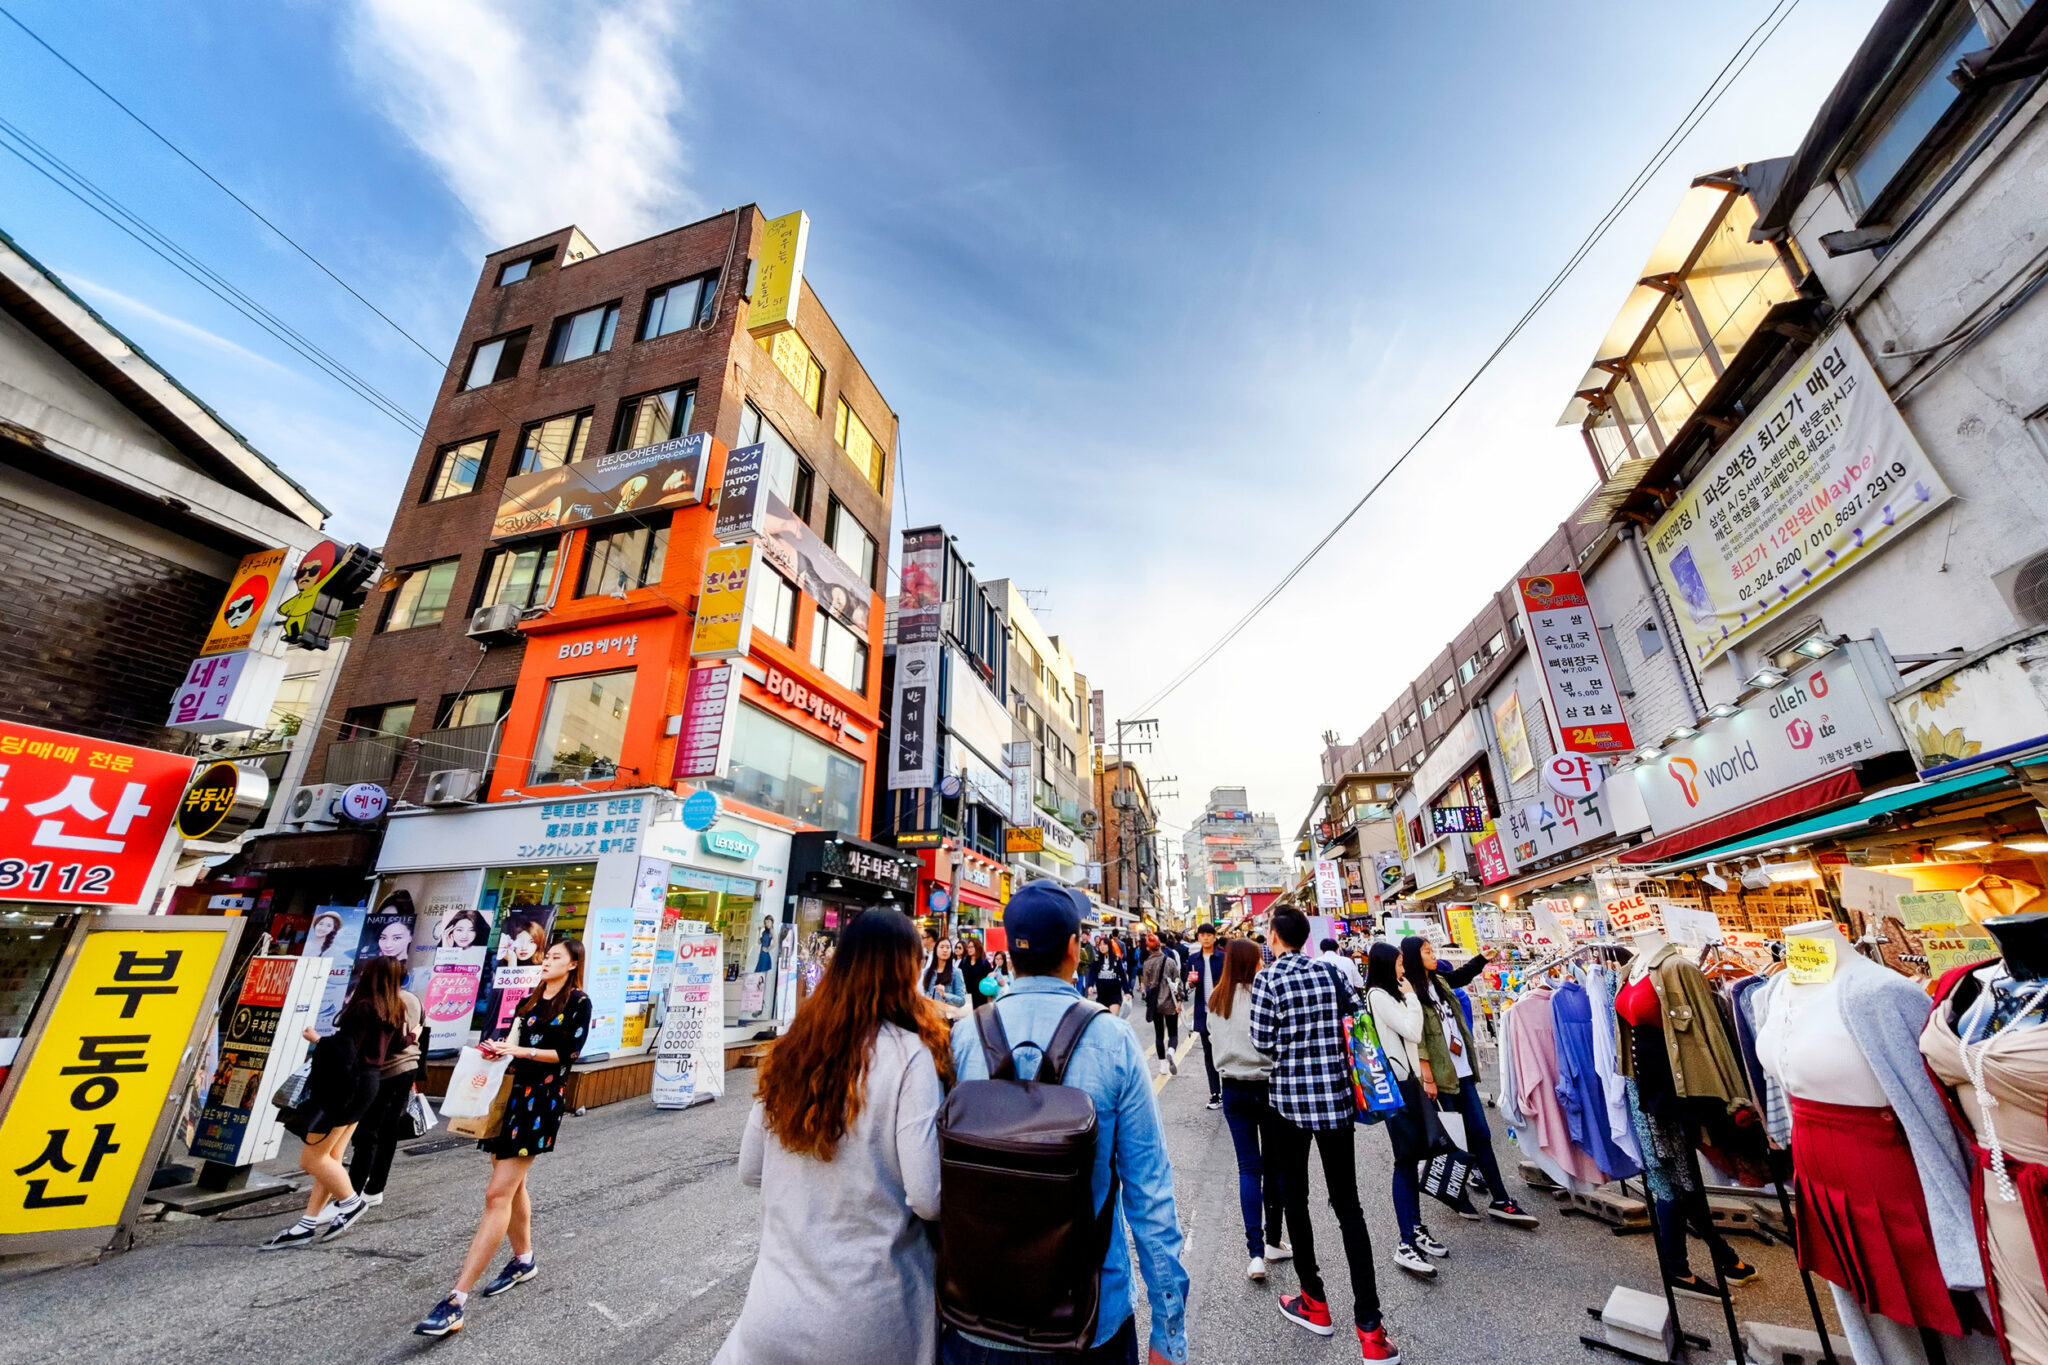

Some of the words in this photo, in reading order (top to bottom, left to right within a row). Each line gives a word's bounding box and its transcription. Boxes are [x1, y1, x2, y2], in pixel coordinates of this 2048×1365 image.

[596, 444, 659, 468] LEEJOOHEE
[660, 435, 702, 453] HENNA
[597, 447, 694, 474] www.hennatattoo.co.kr
[730, 448, 761, 462] ヘンナ
[1656, 508, 1693, 554] 깨진액정
[1702, 444, 1757, 507] 파손액정
[1758, 392, 1805, 451] 최고가
[1805, 346, 1847, 397] 매입
[1709, 507, 1727, 529] 삼성
[1727, 434, 1801, 514] A/S서비스센터에
[1800, 375, 1857, 438] 방문하시고
[724, 473, 759, 488] TATTOO
[726, 462, 759, 476] HENNA
[1714, 521, 1733, 541] 깨진
[1732, 495, 1761, 525] 액정을
[1761, 414, 1843, 501] 교체받아오세요!!!
[728, 485, 748, 498] 文身
[1731, 542, 1768, 580] 최고가
[1769, 444, 1877, 550] 12만원(Maybe)
[1738, 547, 1802, 601] 02.324.6200
[1810, 461, 1907, 547] 010.8697.2919
[1544, 631, 1590, 646] 순대국
[1548, 654, 1599, 669] 뼈해장국
[174, 658, 220, 724] 네일
[1769, 686, 1808, 719] olleh
[1565, 703, 1613, 718] 삼겹살
[904, 690, 921, 765] 반지마켓
[1572, 727, 1597, 745] 24
[0, 735, 80, 764] 딩매매
[88, 750, 135, 773] 전문
[1703, 739, 1759, 788] world
[1818, 737, 1874, 766] 가람정보통신
[1552, 755, 1593, 792] 약
[0, 763, 152, 854] 산
[184, 786, 235, 812] 부동산
[354, 794, 383, 811] 헤어
[541, 802, 599, 820] 콘택트렌즈
[607, 797, 644, 815] 전문점
[1508, 808, 1530, 840] 홍대
[1540, 791, 1603, 846] 수약국
[1016, 827, 1042, 841] 부동산
[517, 840, 596, 858] コンタクトレンズ
[1545, 900, 1571, 913] ALE
[1607, 895, 1645, 915] SALE
[1928, 939, 1966, 951] SALE
[328, 968, 346, 976] ALE
[13, 949, 184, 1210] 부동산
[1369, 1060, 1394, 1104] LOVE
